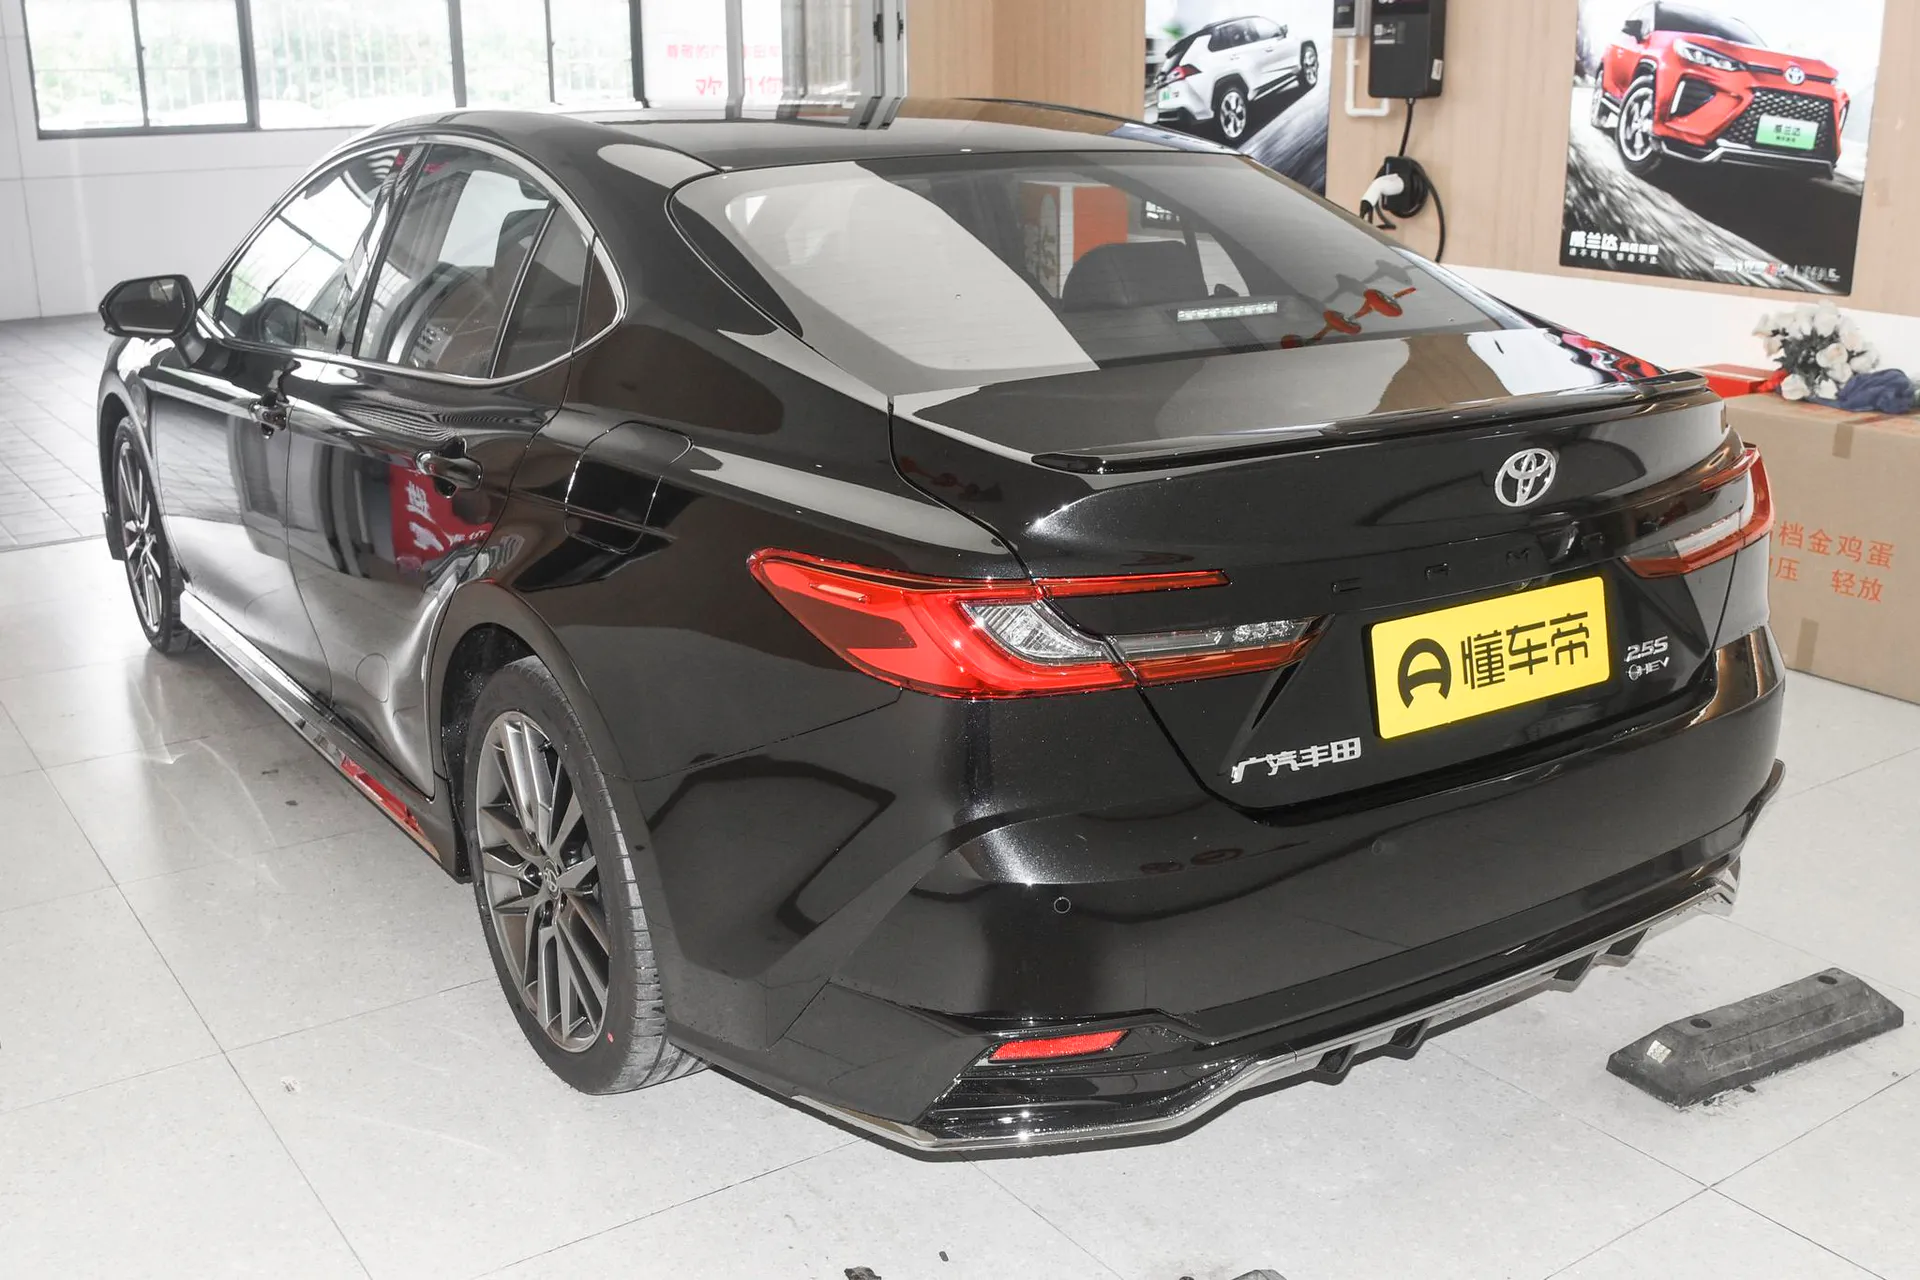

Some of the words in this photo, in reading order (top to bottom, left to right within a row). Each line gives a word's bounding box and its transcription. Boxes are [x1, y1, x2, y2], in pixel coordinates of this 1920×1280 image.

[1770, 519, 1895, 570] 档金鸡蛋
[1830, 568, 1884, 602] 轻放
[1460, 611, 1590, 690] 懂车帝
[1230, 736, 1362, 784] 广汽丰田
